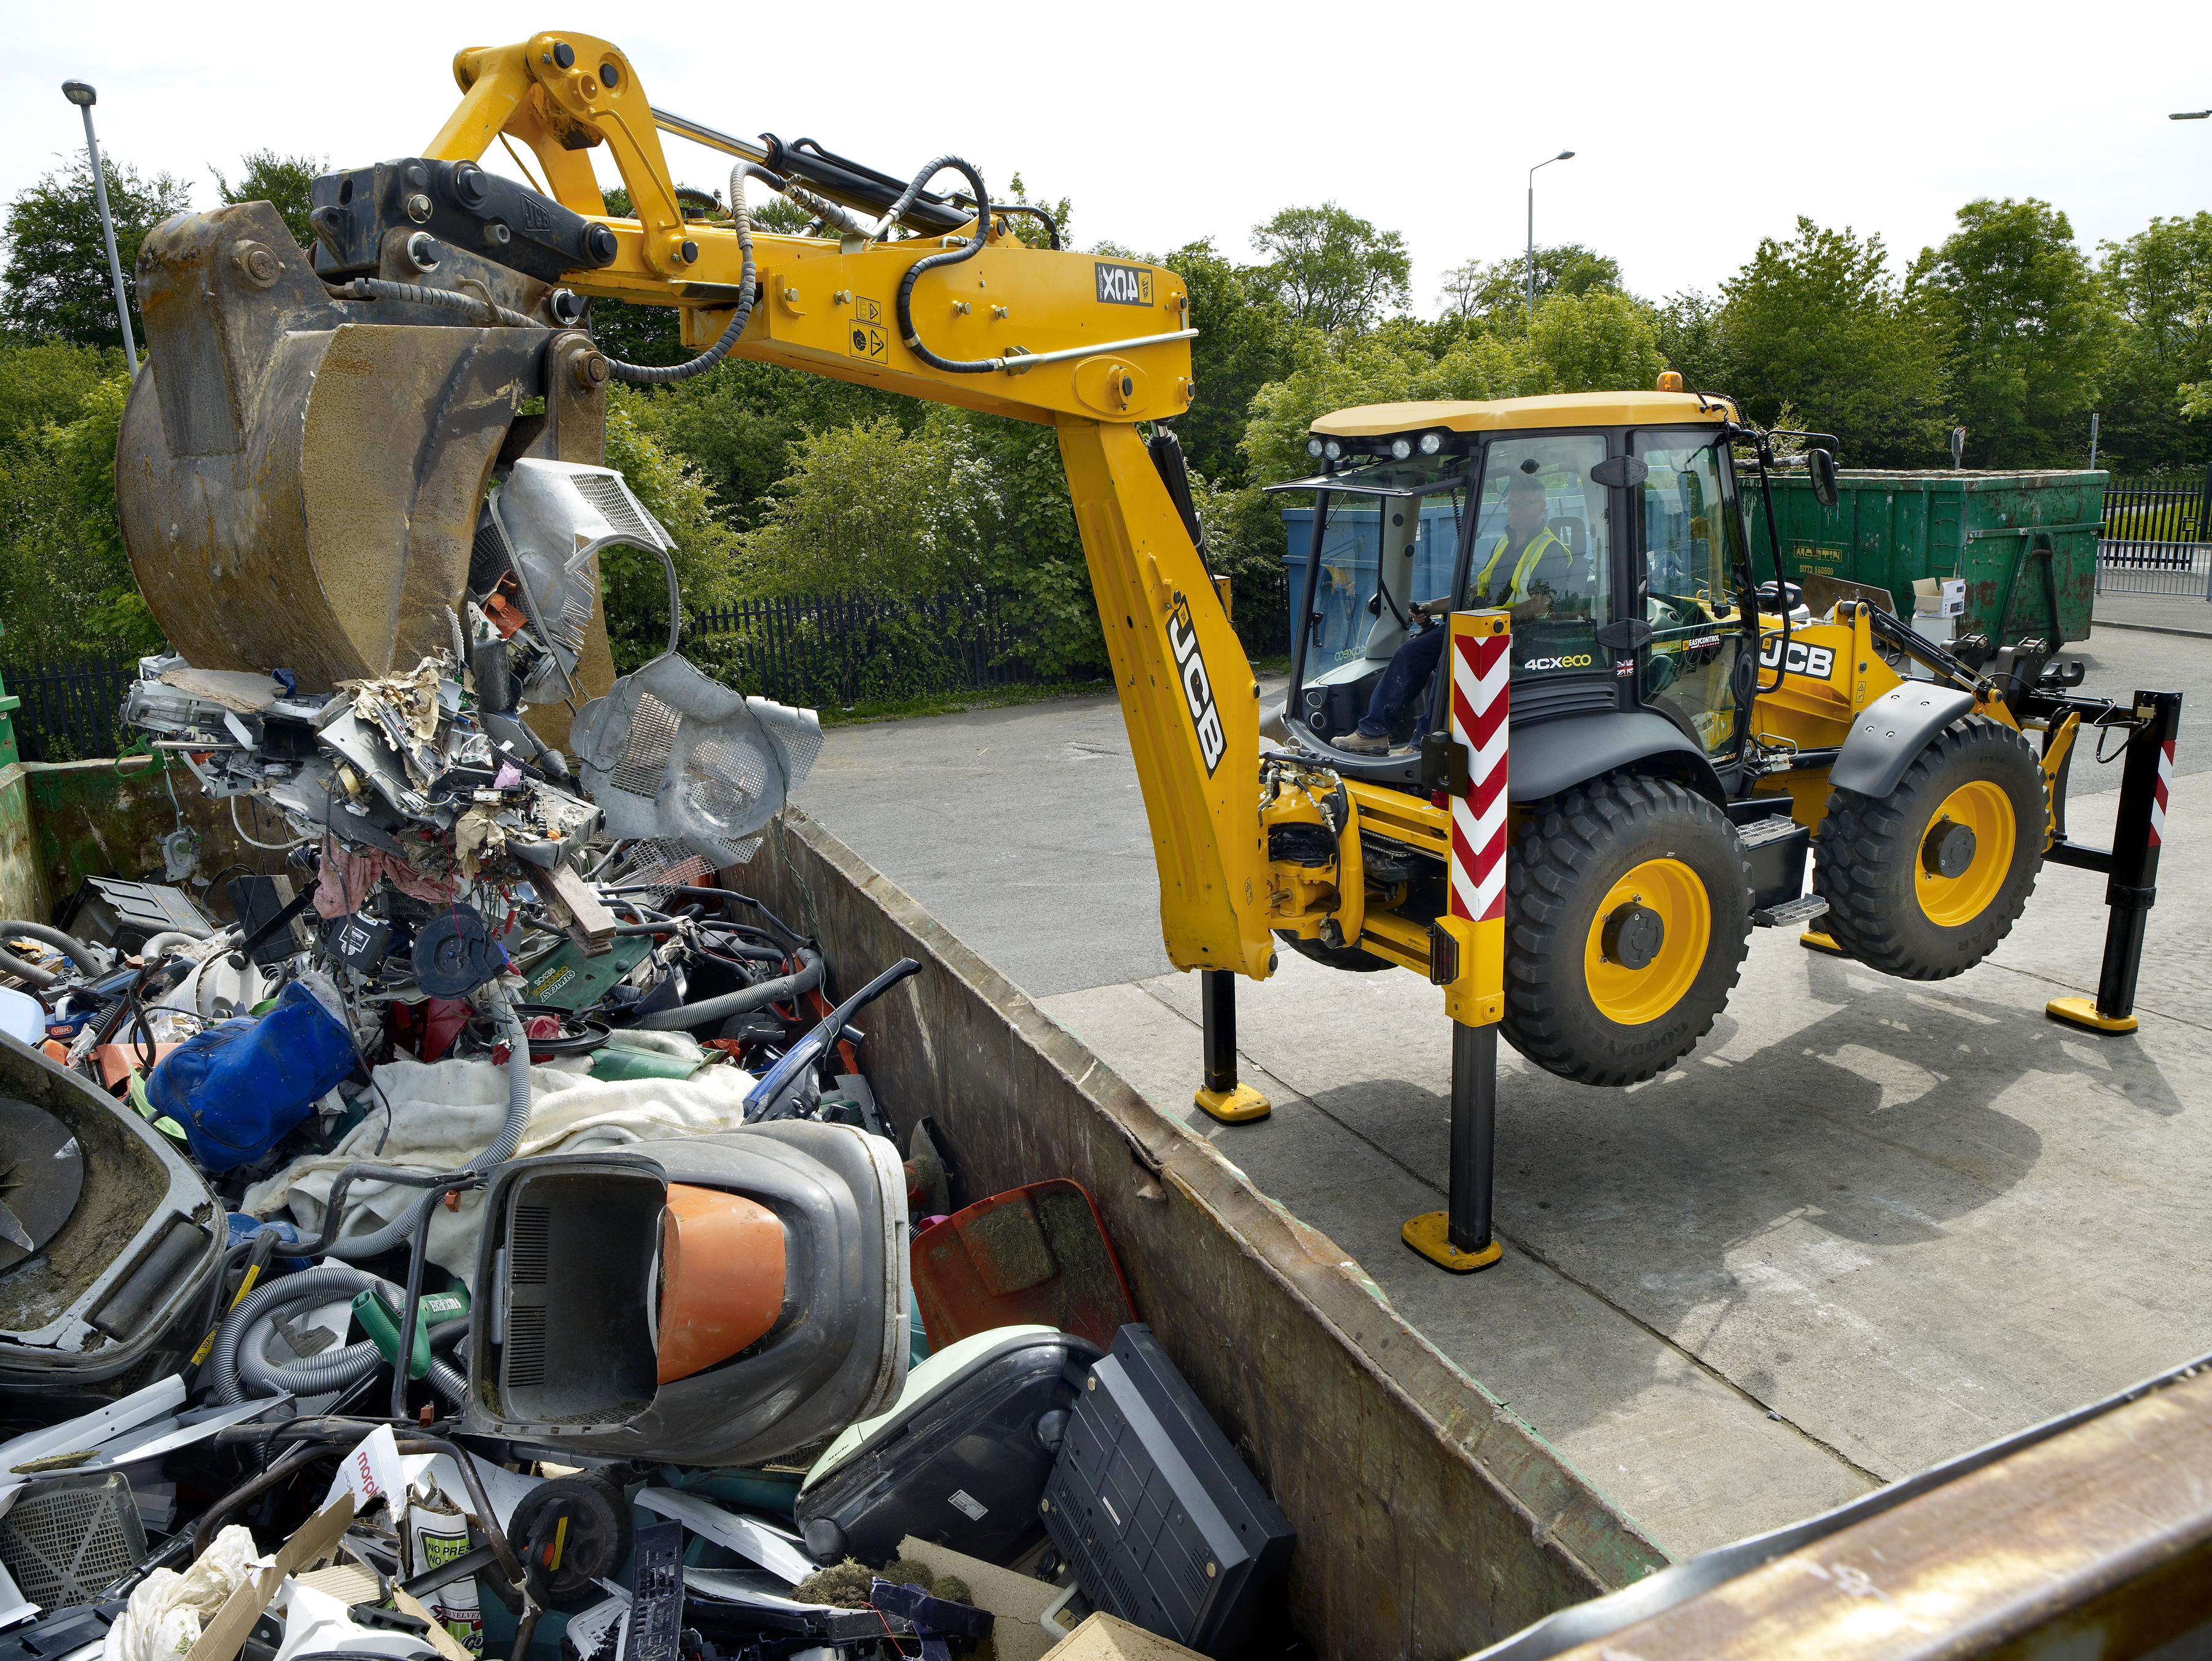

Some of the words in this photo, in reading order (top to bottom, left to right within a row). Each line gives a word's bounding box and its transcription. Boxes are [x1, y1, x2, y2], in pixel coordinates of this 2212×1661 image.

[525, 198, 549, 229] JCB
[1102, 265, 1138, 301] 4CX
[1800, 564, 1813, 573] 01773
[1689, 634, 1720, 648] EASYCONTROL
[1524, 653, 1592, 670] 4CXeco
[1760, 640, 1833, 677] JCB
[1170, 616, 1223, 770] JCB
[1709, 714, 1733, 746] JCB
[531, 965, 569, 997] CONCORDE
[539, 968, 576, 1003] QUALCAST
[828, 1444, 849, 1462] Miele
[949, 1491, 962, 1501] Miele
[428, 1544, 440, 1553] NO
[429, 1555, 441, 1565] NO
